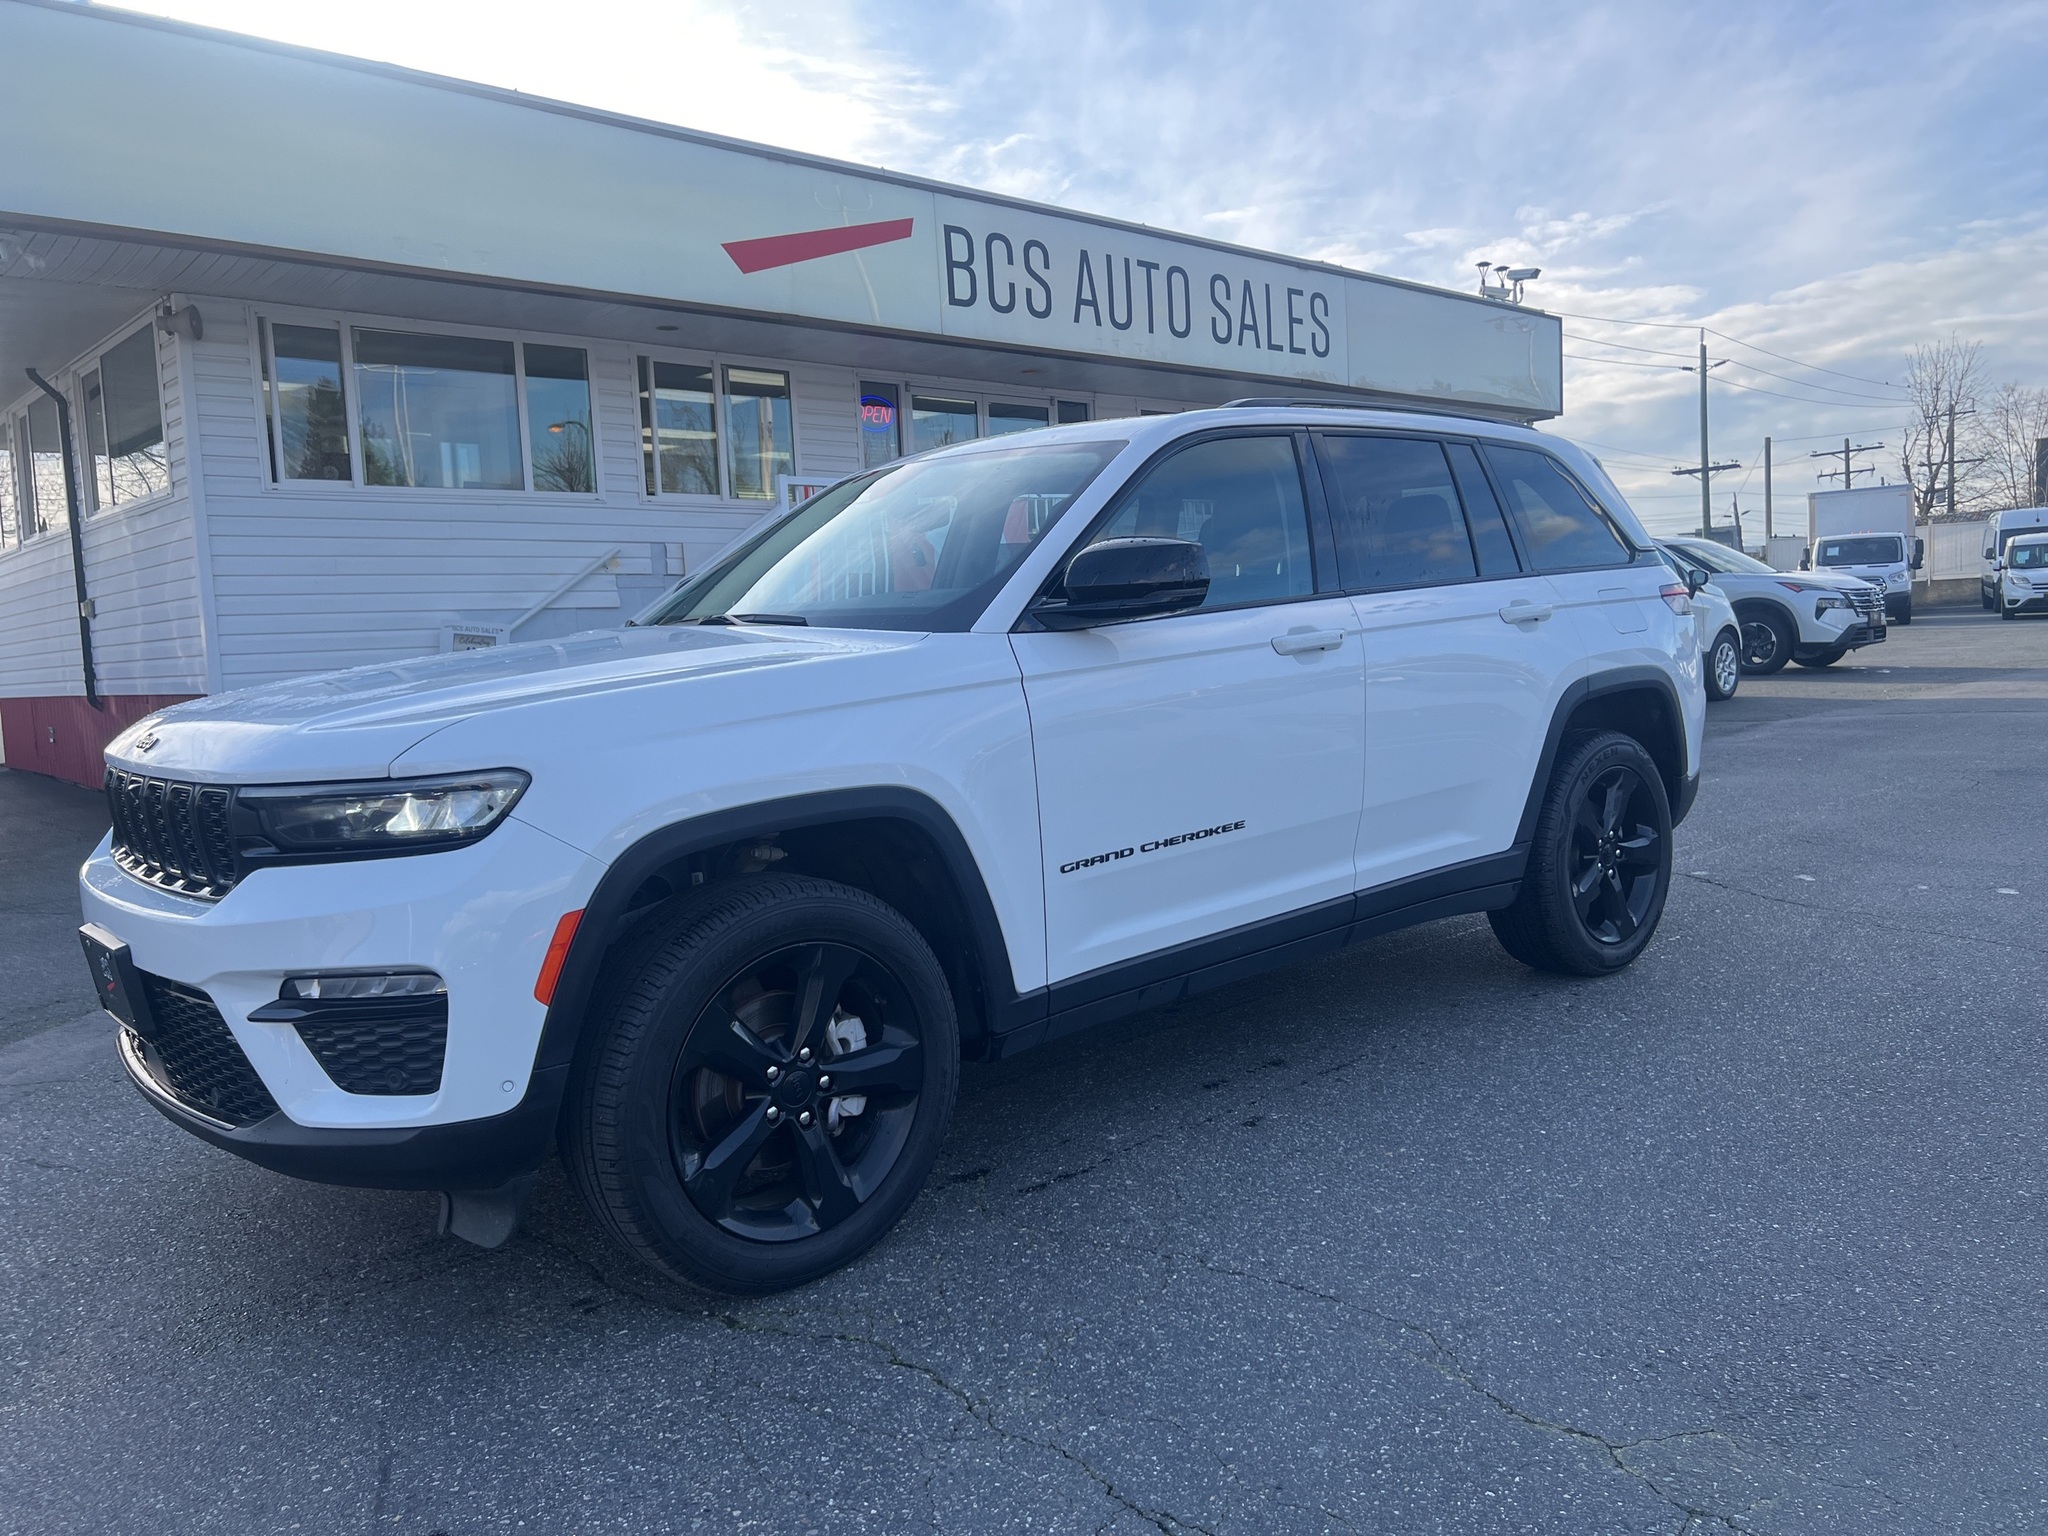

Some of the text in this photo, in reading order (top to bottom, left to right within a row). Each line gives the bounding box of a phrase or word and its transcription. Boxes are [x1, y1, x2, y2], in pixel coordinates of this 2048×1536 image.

[943, 224, 1330, 358] BCS AUTO SALES
[481, 627, 499, 635] SALES
[1580, 746, 1619, 785] NEXEN
[1060, 820, 1246, 874] GRAND CHEROKEE
